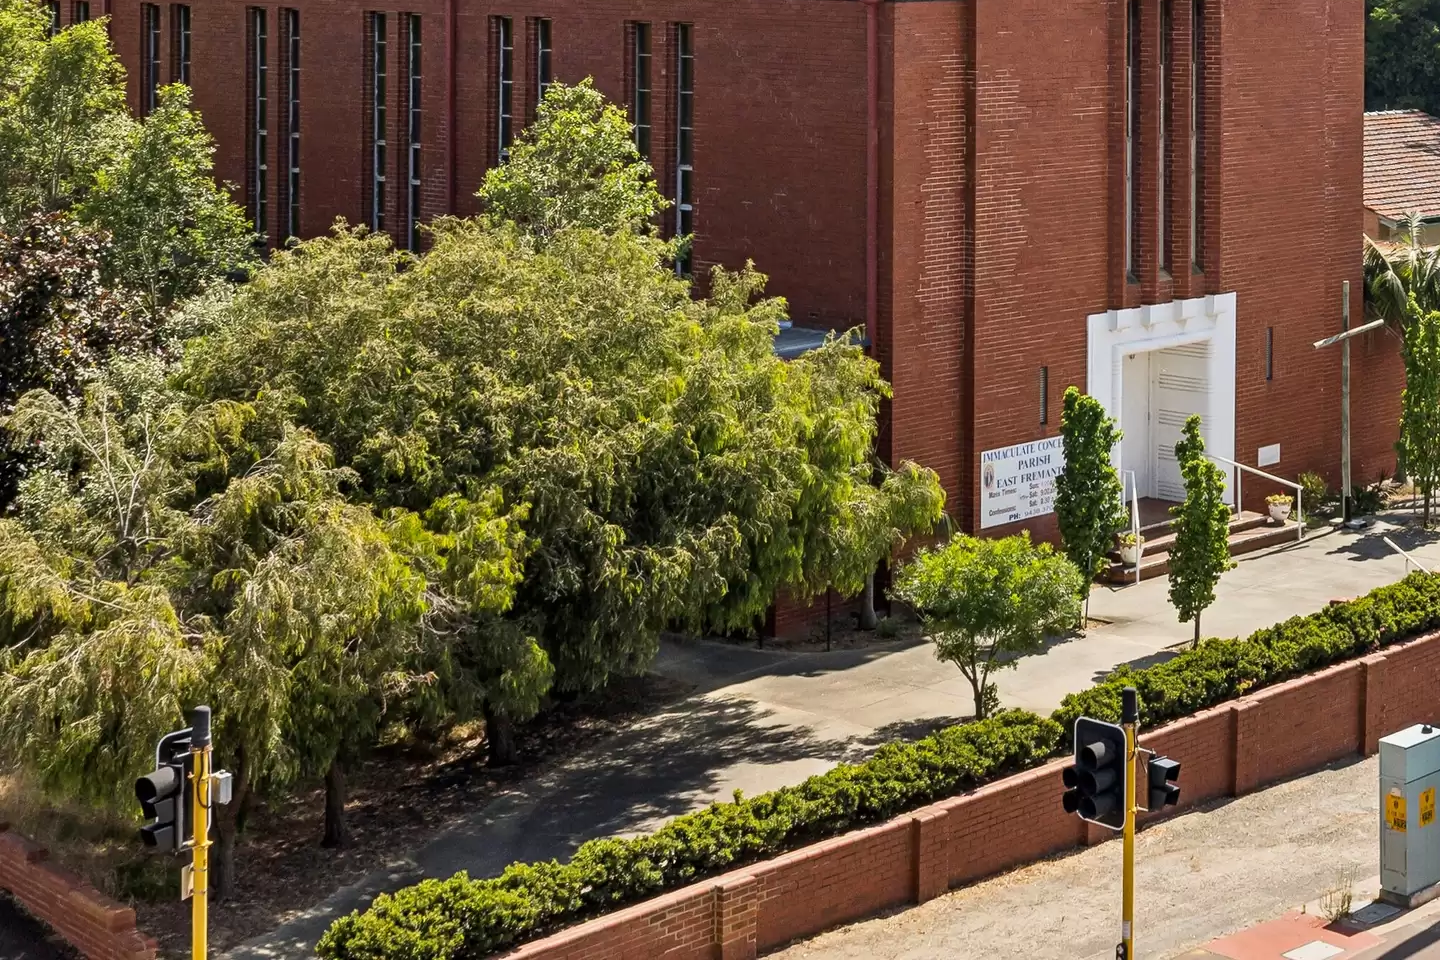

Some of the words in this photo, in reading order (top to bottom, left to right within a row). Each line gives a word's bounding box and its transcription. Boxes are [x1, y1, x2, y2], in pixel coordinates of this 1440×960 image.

[983, 443, 1036, 463] IMMACULATE
[1018, 454, 1051, 470] PARISH
[996, 476, 1018, 488] EAST
[1009, 513, 1021, 521] PH:
